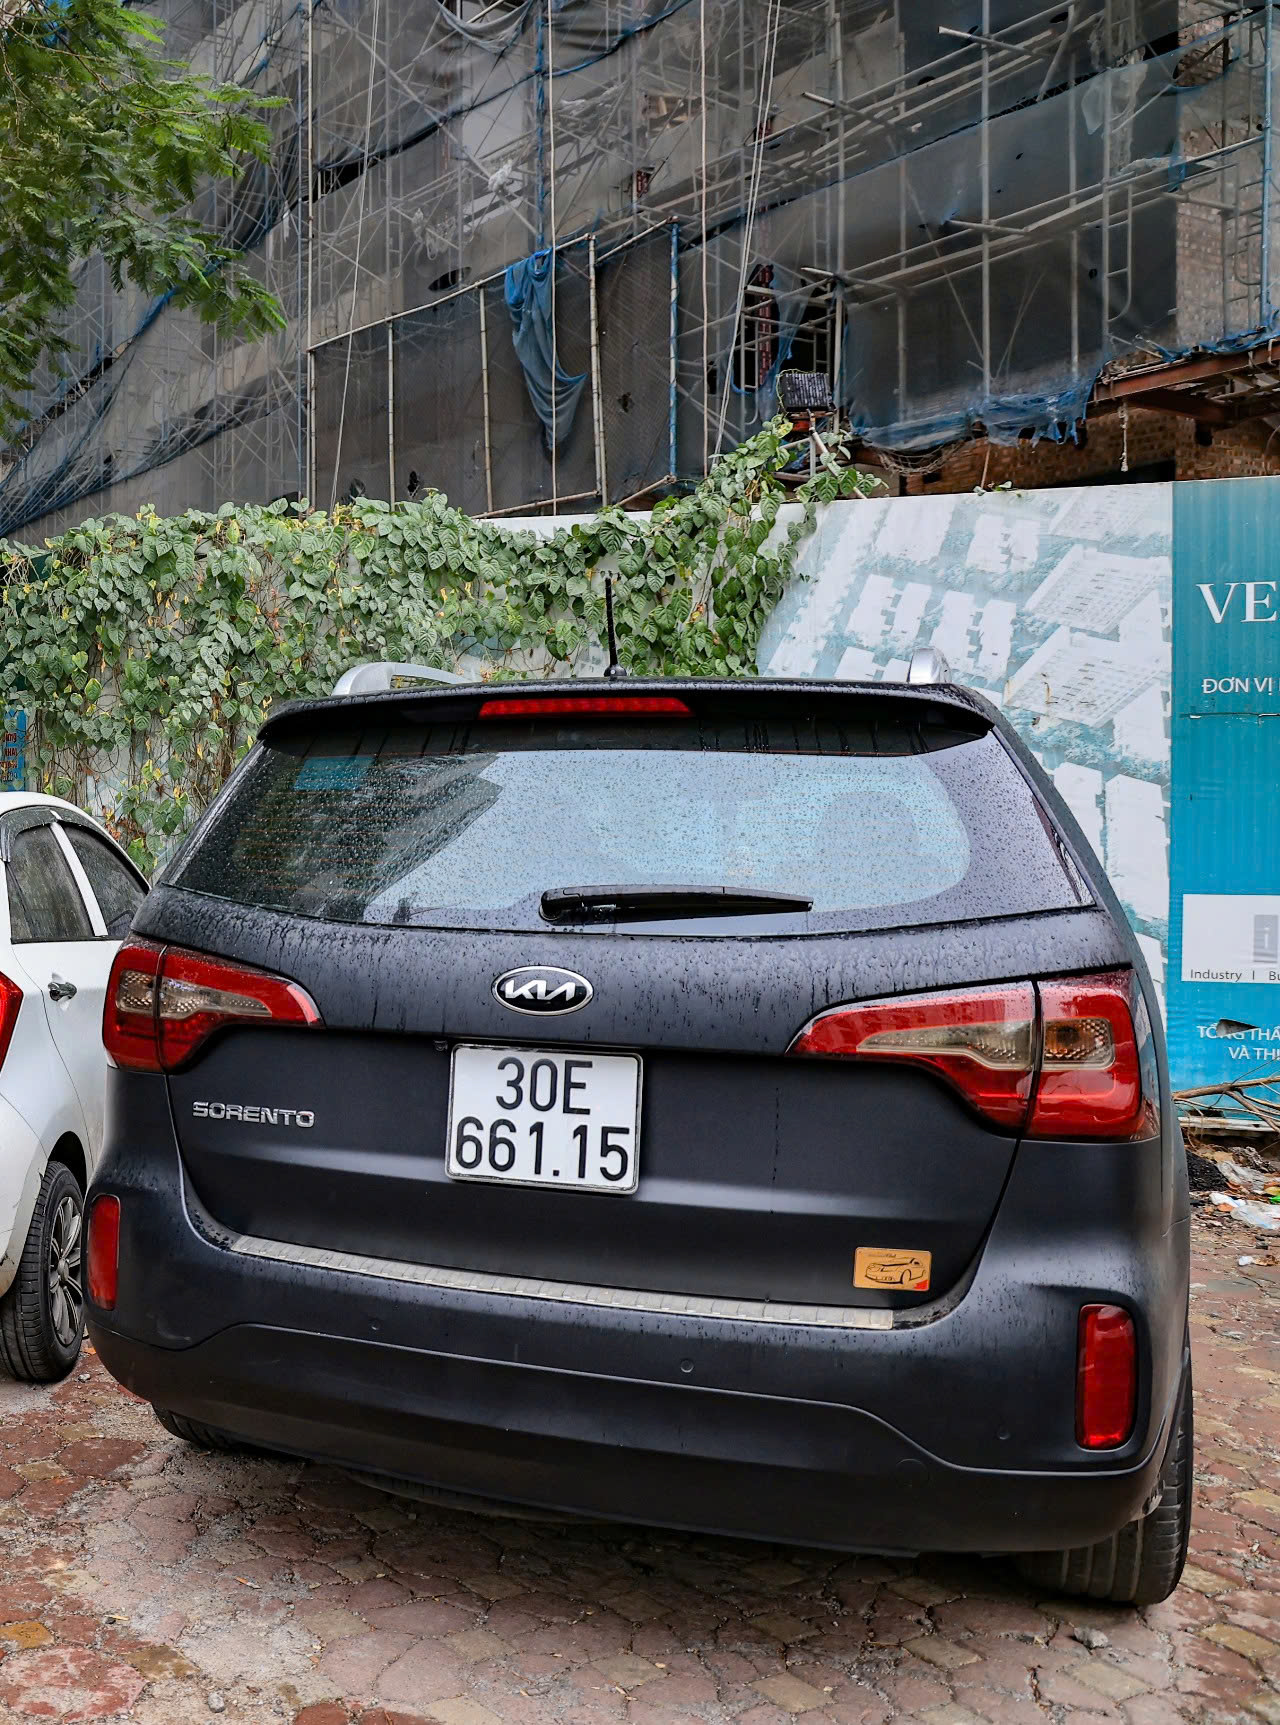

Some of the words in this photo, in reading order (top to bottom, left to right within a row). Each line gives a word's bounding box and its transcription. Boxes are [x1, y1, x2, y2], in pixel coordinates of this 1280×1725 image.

[1201, 676, 1250, 694] ĐƠN
[1253, 677, 1273, 696] VỊ
[1190, 969, 1243, 983] Industry
[1228, 1045, 1250, 1060] VÀ
[496, 1056, 593, 1115] 30E
[192, 1101, 315, 1128] SORENTO
[455, 1116, 630, 1182] 661.15
